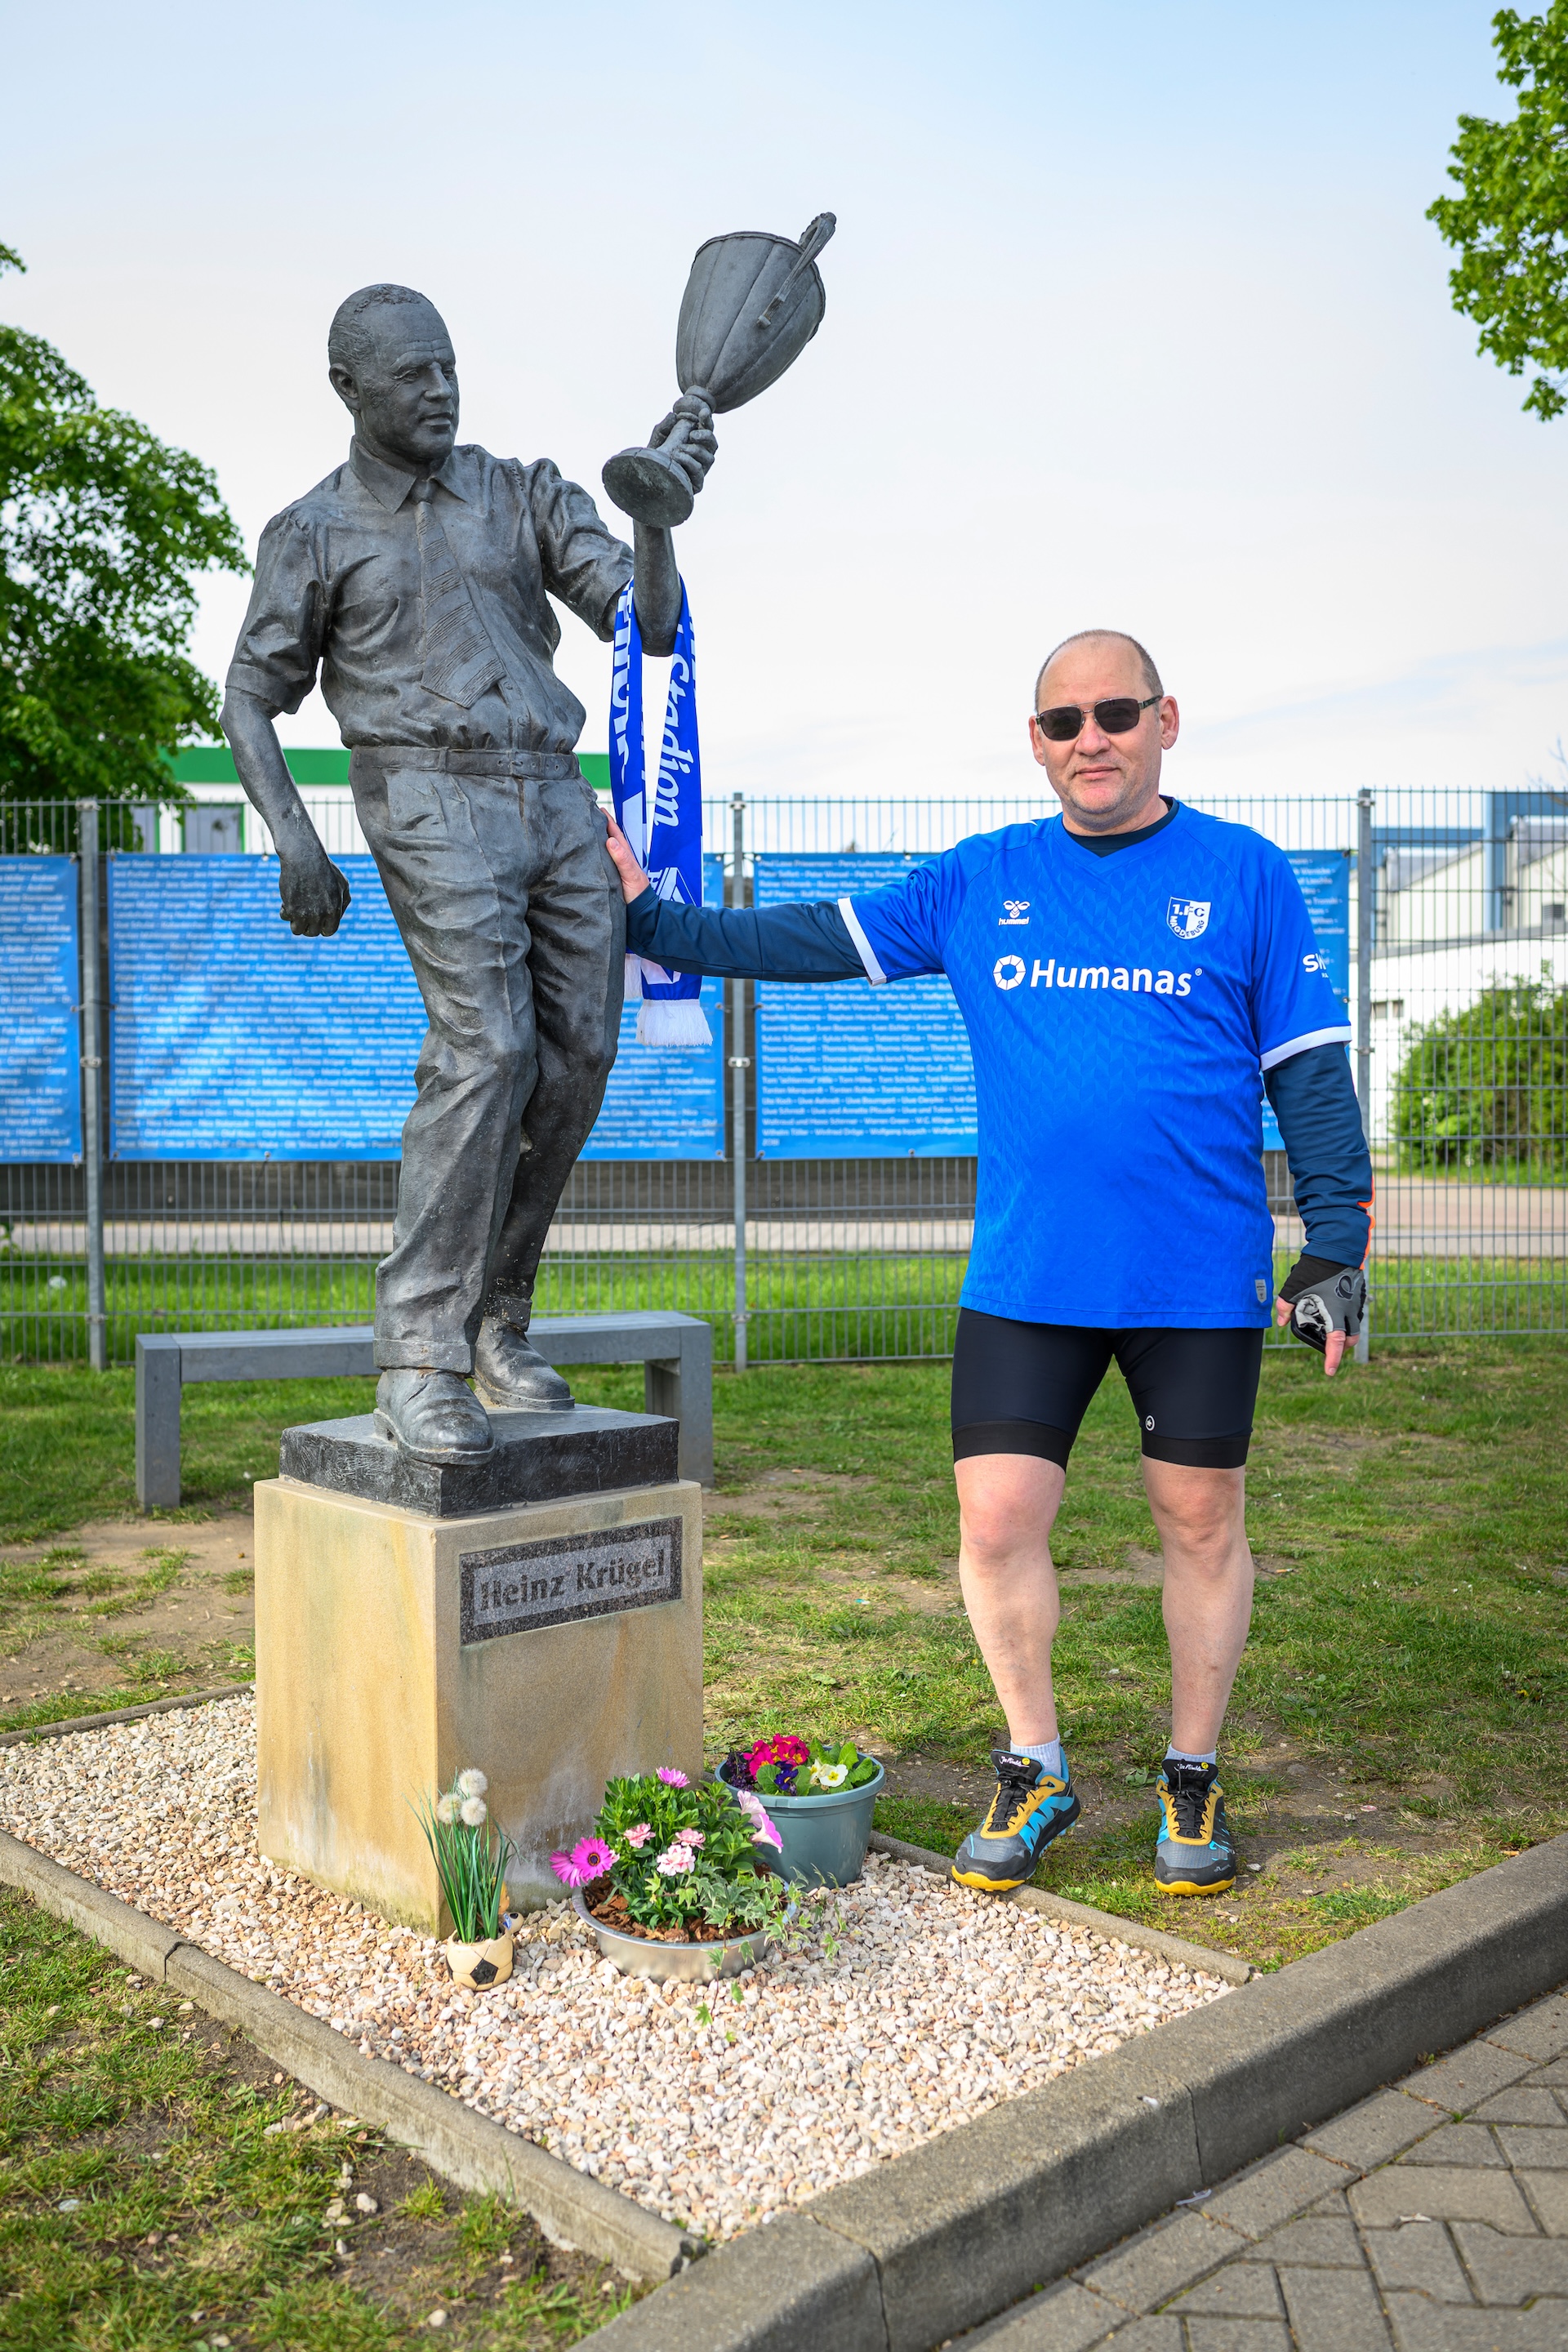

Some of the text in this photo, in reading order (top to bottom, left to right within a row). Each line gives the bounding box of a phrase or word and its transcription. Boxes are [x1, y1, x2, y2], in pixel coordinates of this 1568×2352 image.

[654, 653, 694, 827] Stadion
[998, 916, 1030, 926] hummel
[1169, 915, 1205, 938] MAGDEBURG
[480, 1548, 665, 1611] Heinz Krügel
